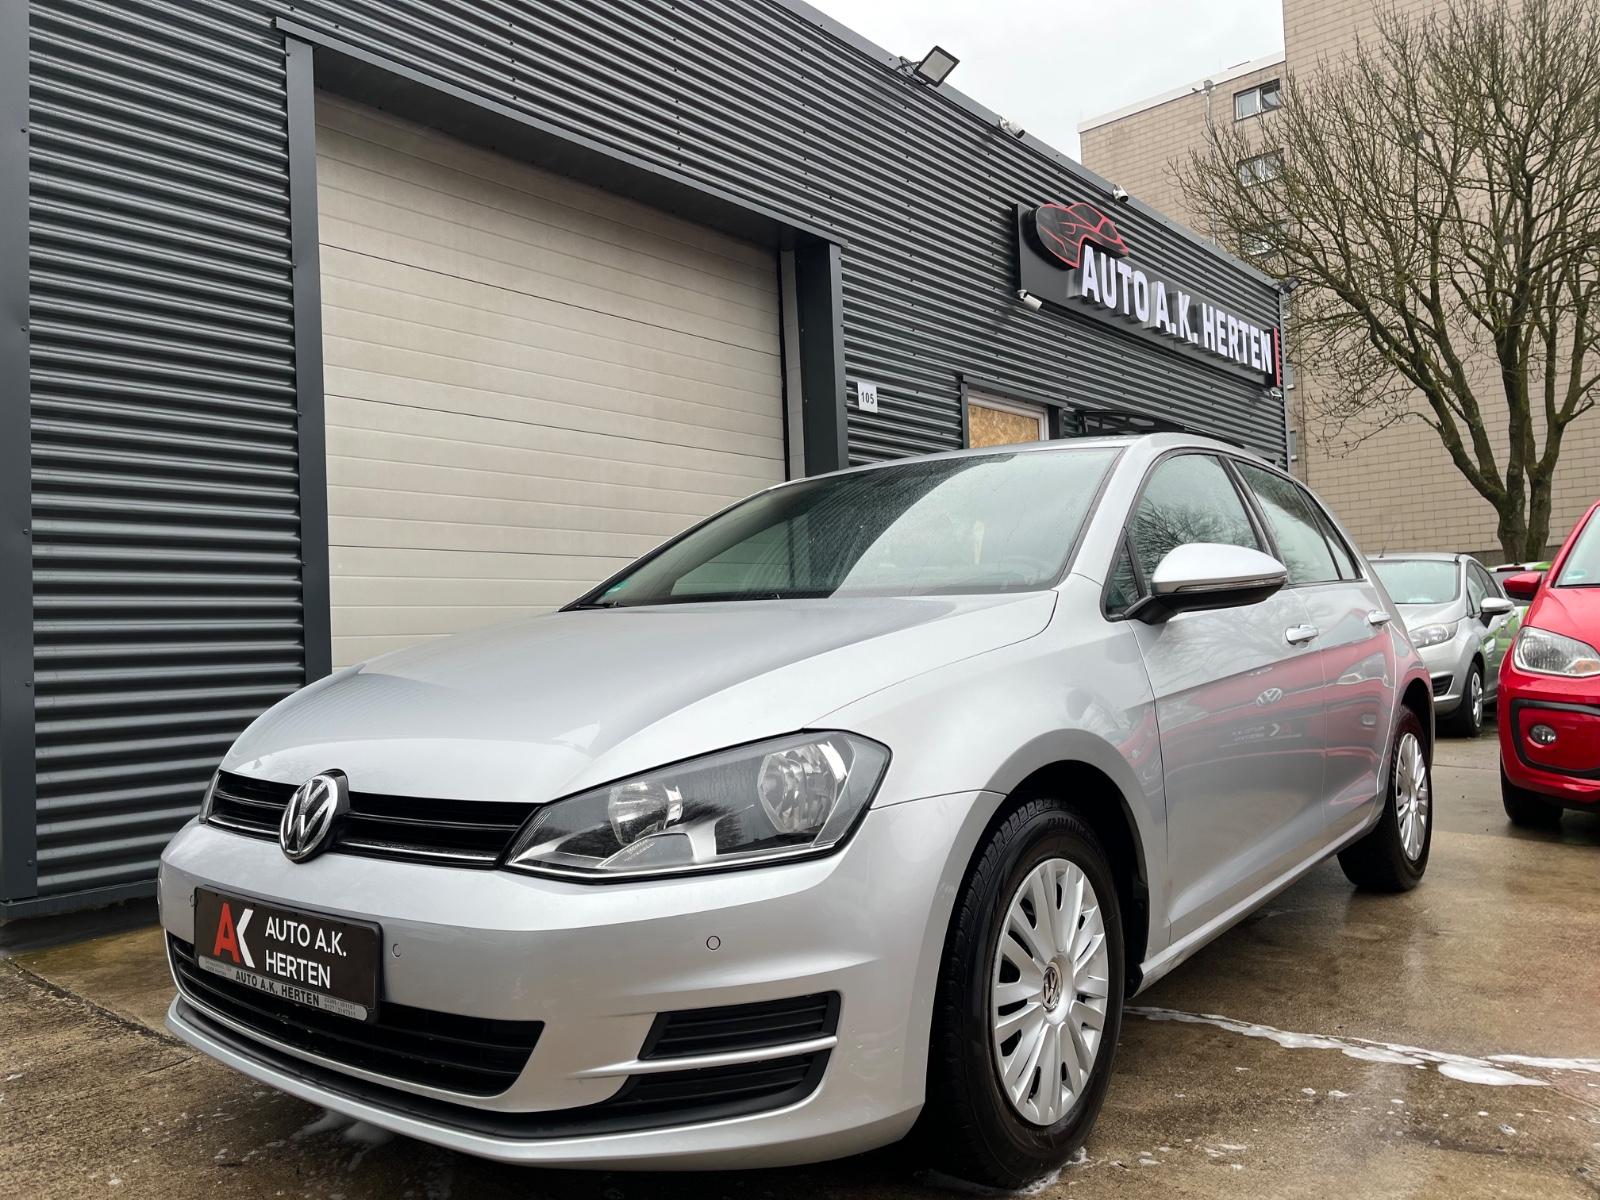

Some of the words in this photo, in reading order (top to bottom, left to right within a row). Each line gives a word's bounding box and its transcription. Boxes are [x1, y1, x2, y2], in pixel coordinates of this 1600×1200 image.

[1081, 244, 1149, 322] AUTO
[1155, 280, 1198, 344] A.K.
[1202, 303, 1273, 374] HERTEN
[861, 391, 875, 405] 105
[281, 774, 338, 860] VW
[213, 902, 255, 968] AK
[265, 916, 310, 947] AUTO
[315, 927, 347, 957] A.K.
[236, 971, 257, 985] AUTO
[281, 985, 319, 1006] HERTEN
[265, 949, 331, 989] HERTEN
